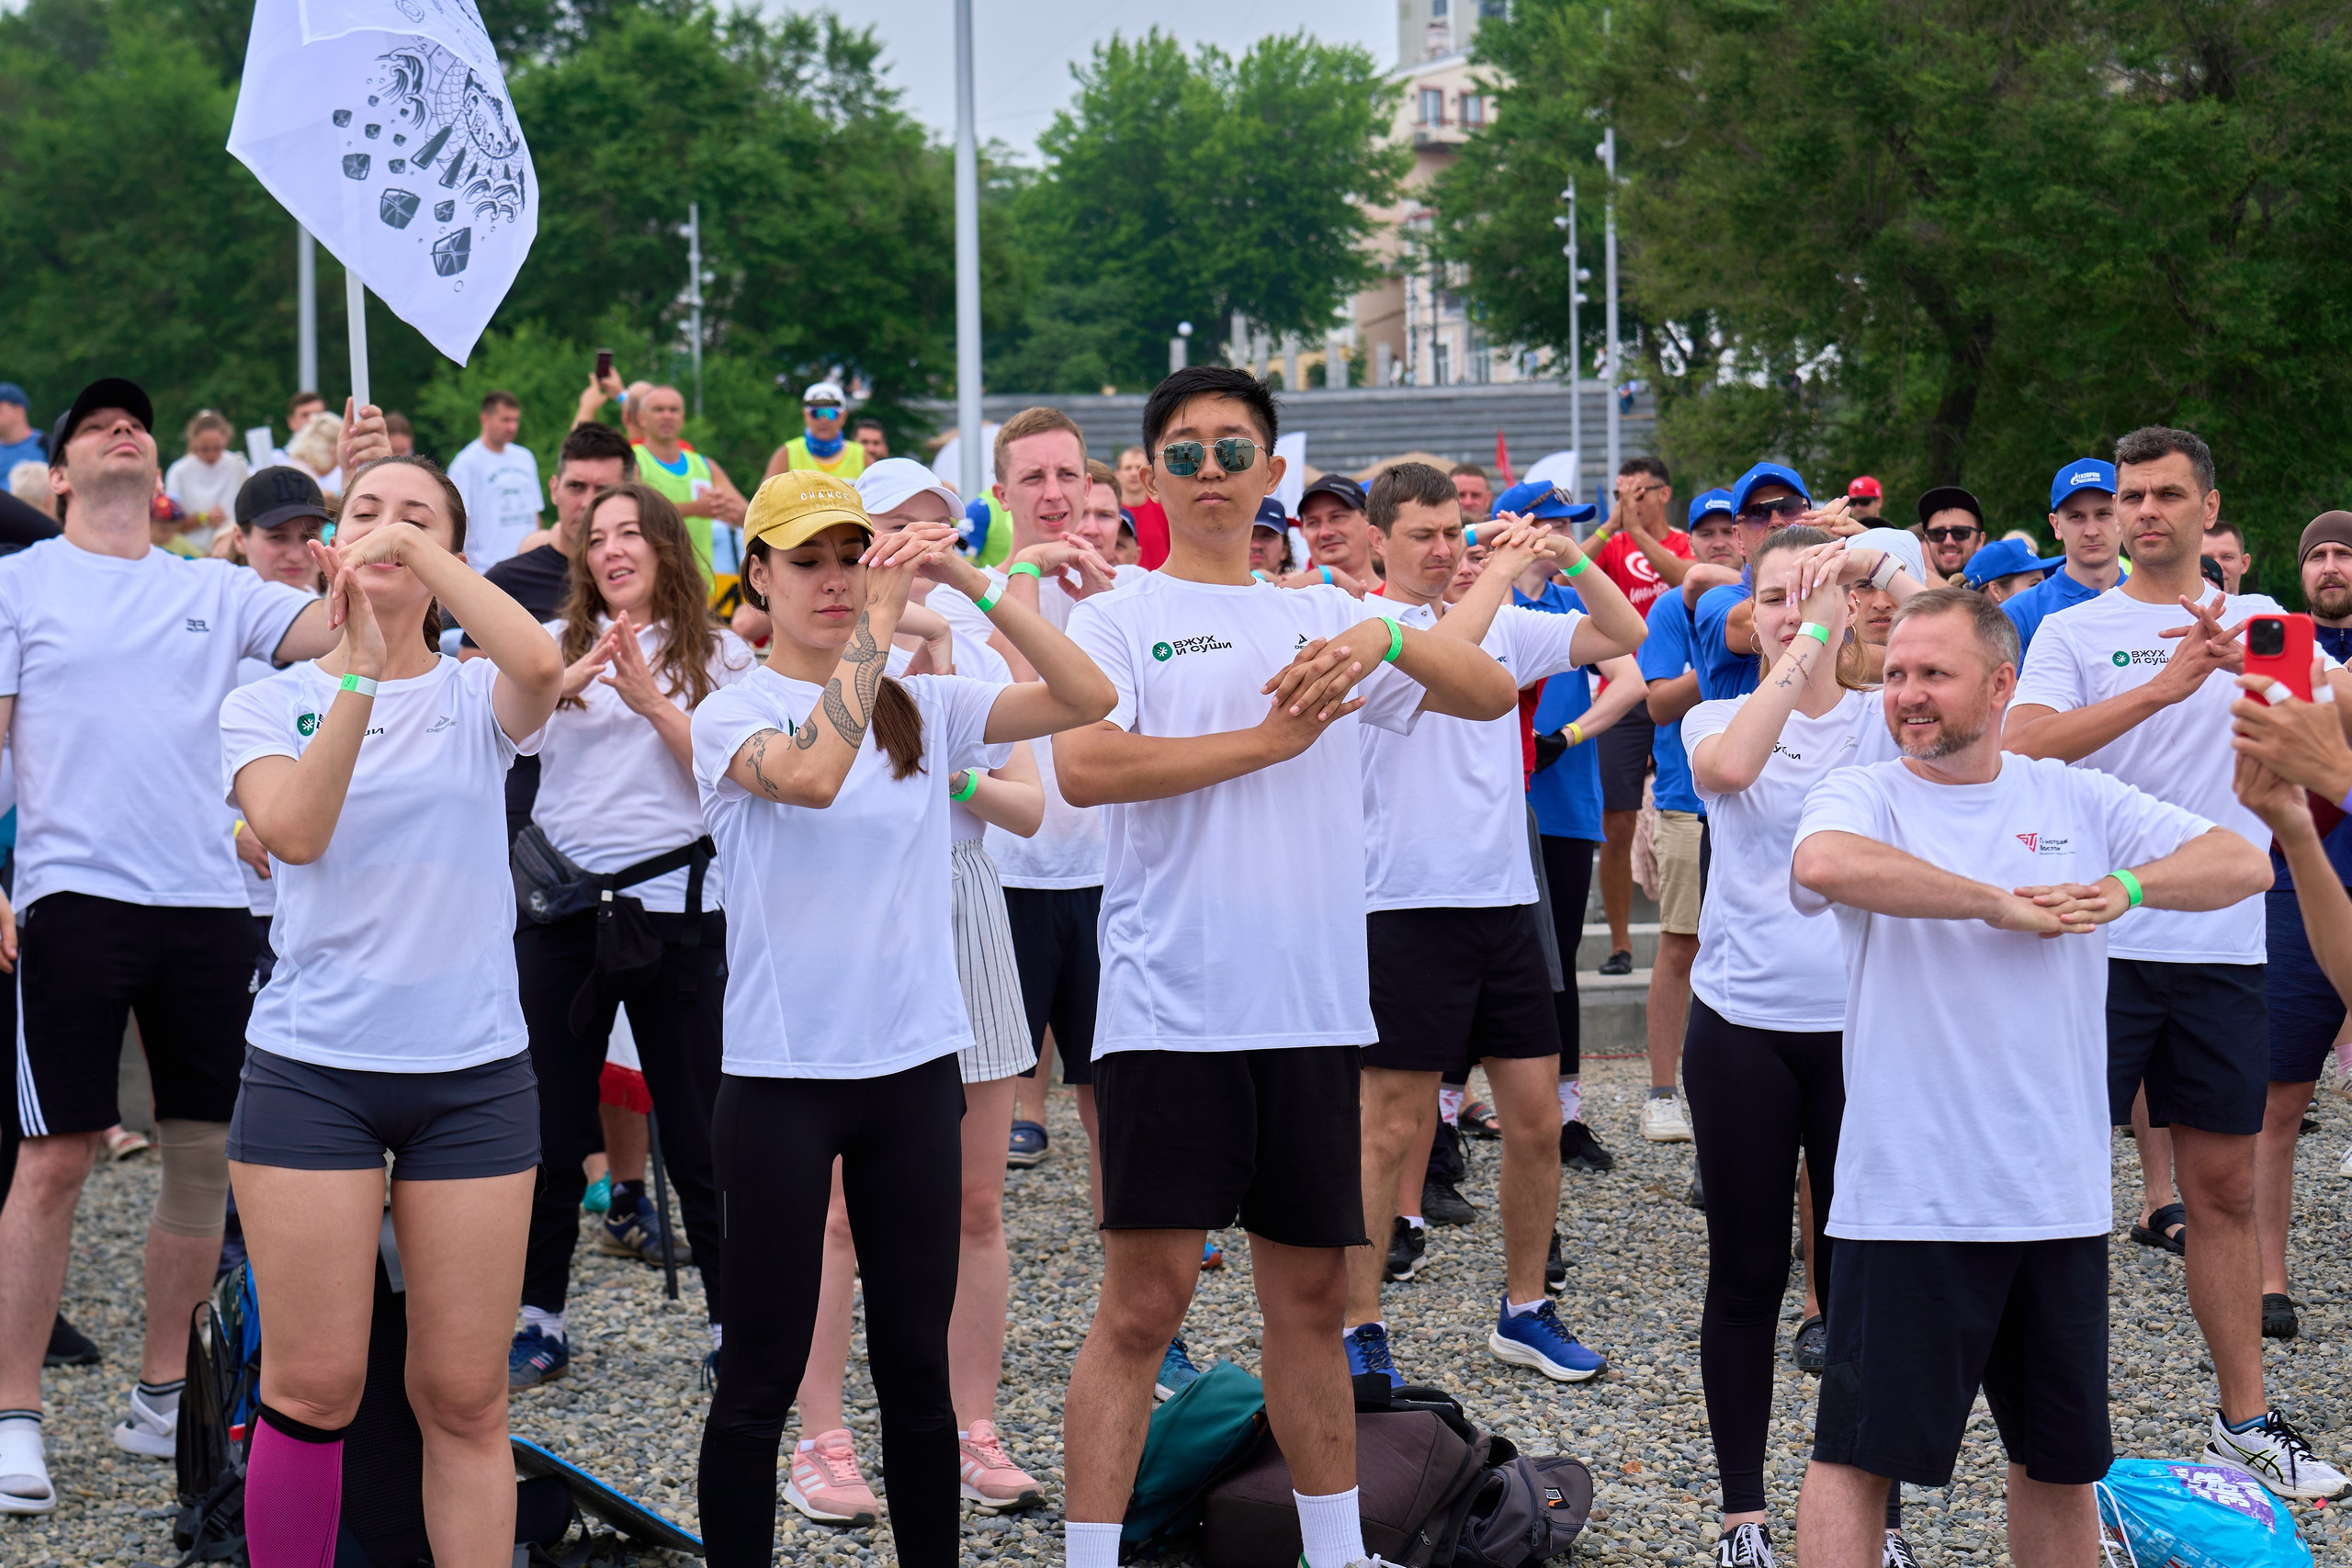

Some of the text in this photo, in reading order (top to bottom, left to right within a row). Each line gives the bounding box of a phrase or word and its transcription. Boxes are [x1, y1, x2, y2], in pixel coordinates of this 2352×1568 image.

[272, 471, 309, 503] 17
[800, 491, 850, 501] CHANCE
[1172, 635, 1216, 649] ВЖУХ
[2131, 649, 2165, 658] ВЖУХ
[2143, 657, 2169, 666] суш
